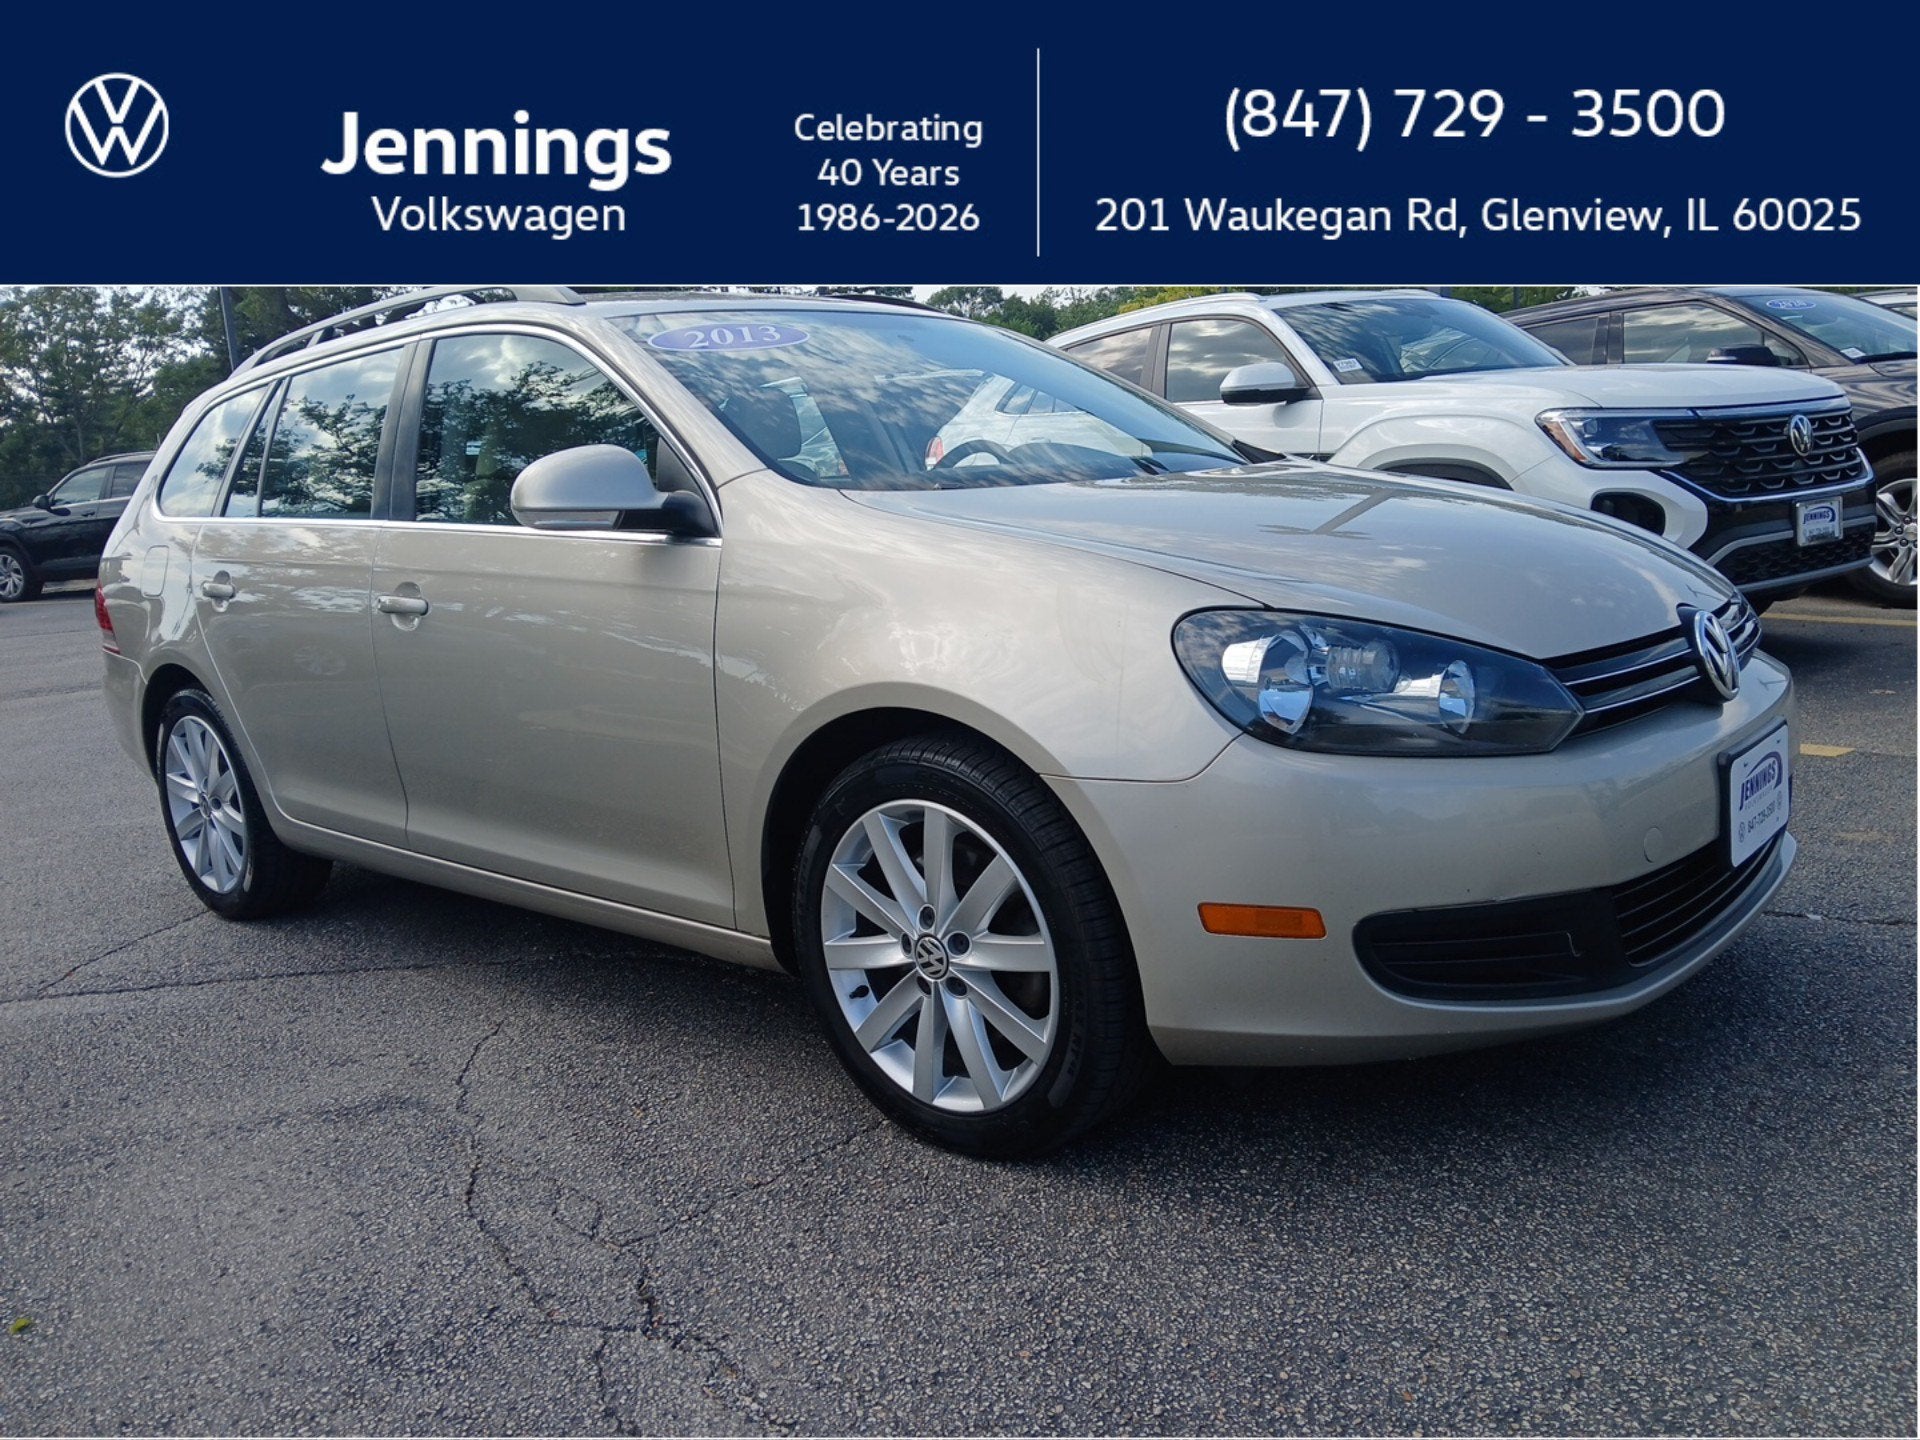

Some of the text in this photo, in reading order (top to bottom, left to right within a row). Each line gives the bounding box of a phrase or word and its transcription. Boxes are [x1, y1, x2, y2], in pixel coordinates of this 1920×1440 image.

[684, 325, 782, 349] 2013
[1803, 509, 1830, 525] JENNINGS
[1739, 760, 1777, 811] JENNINGS
